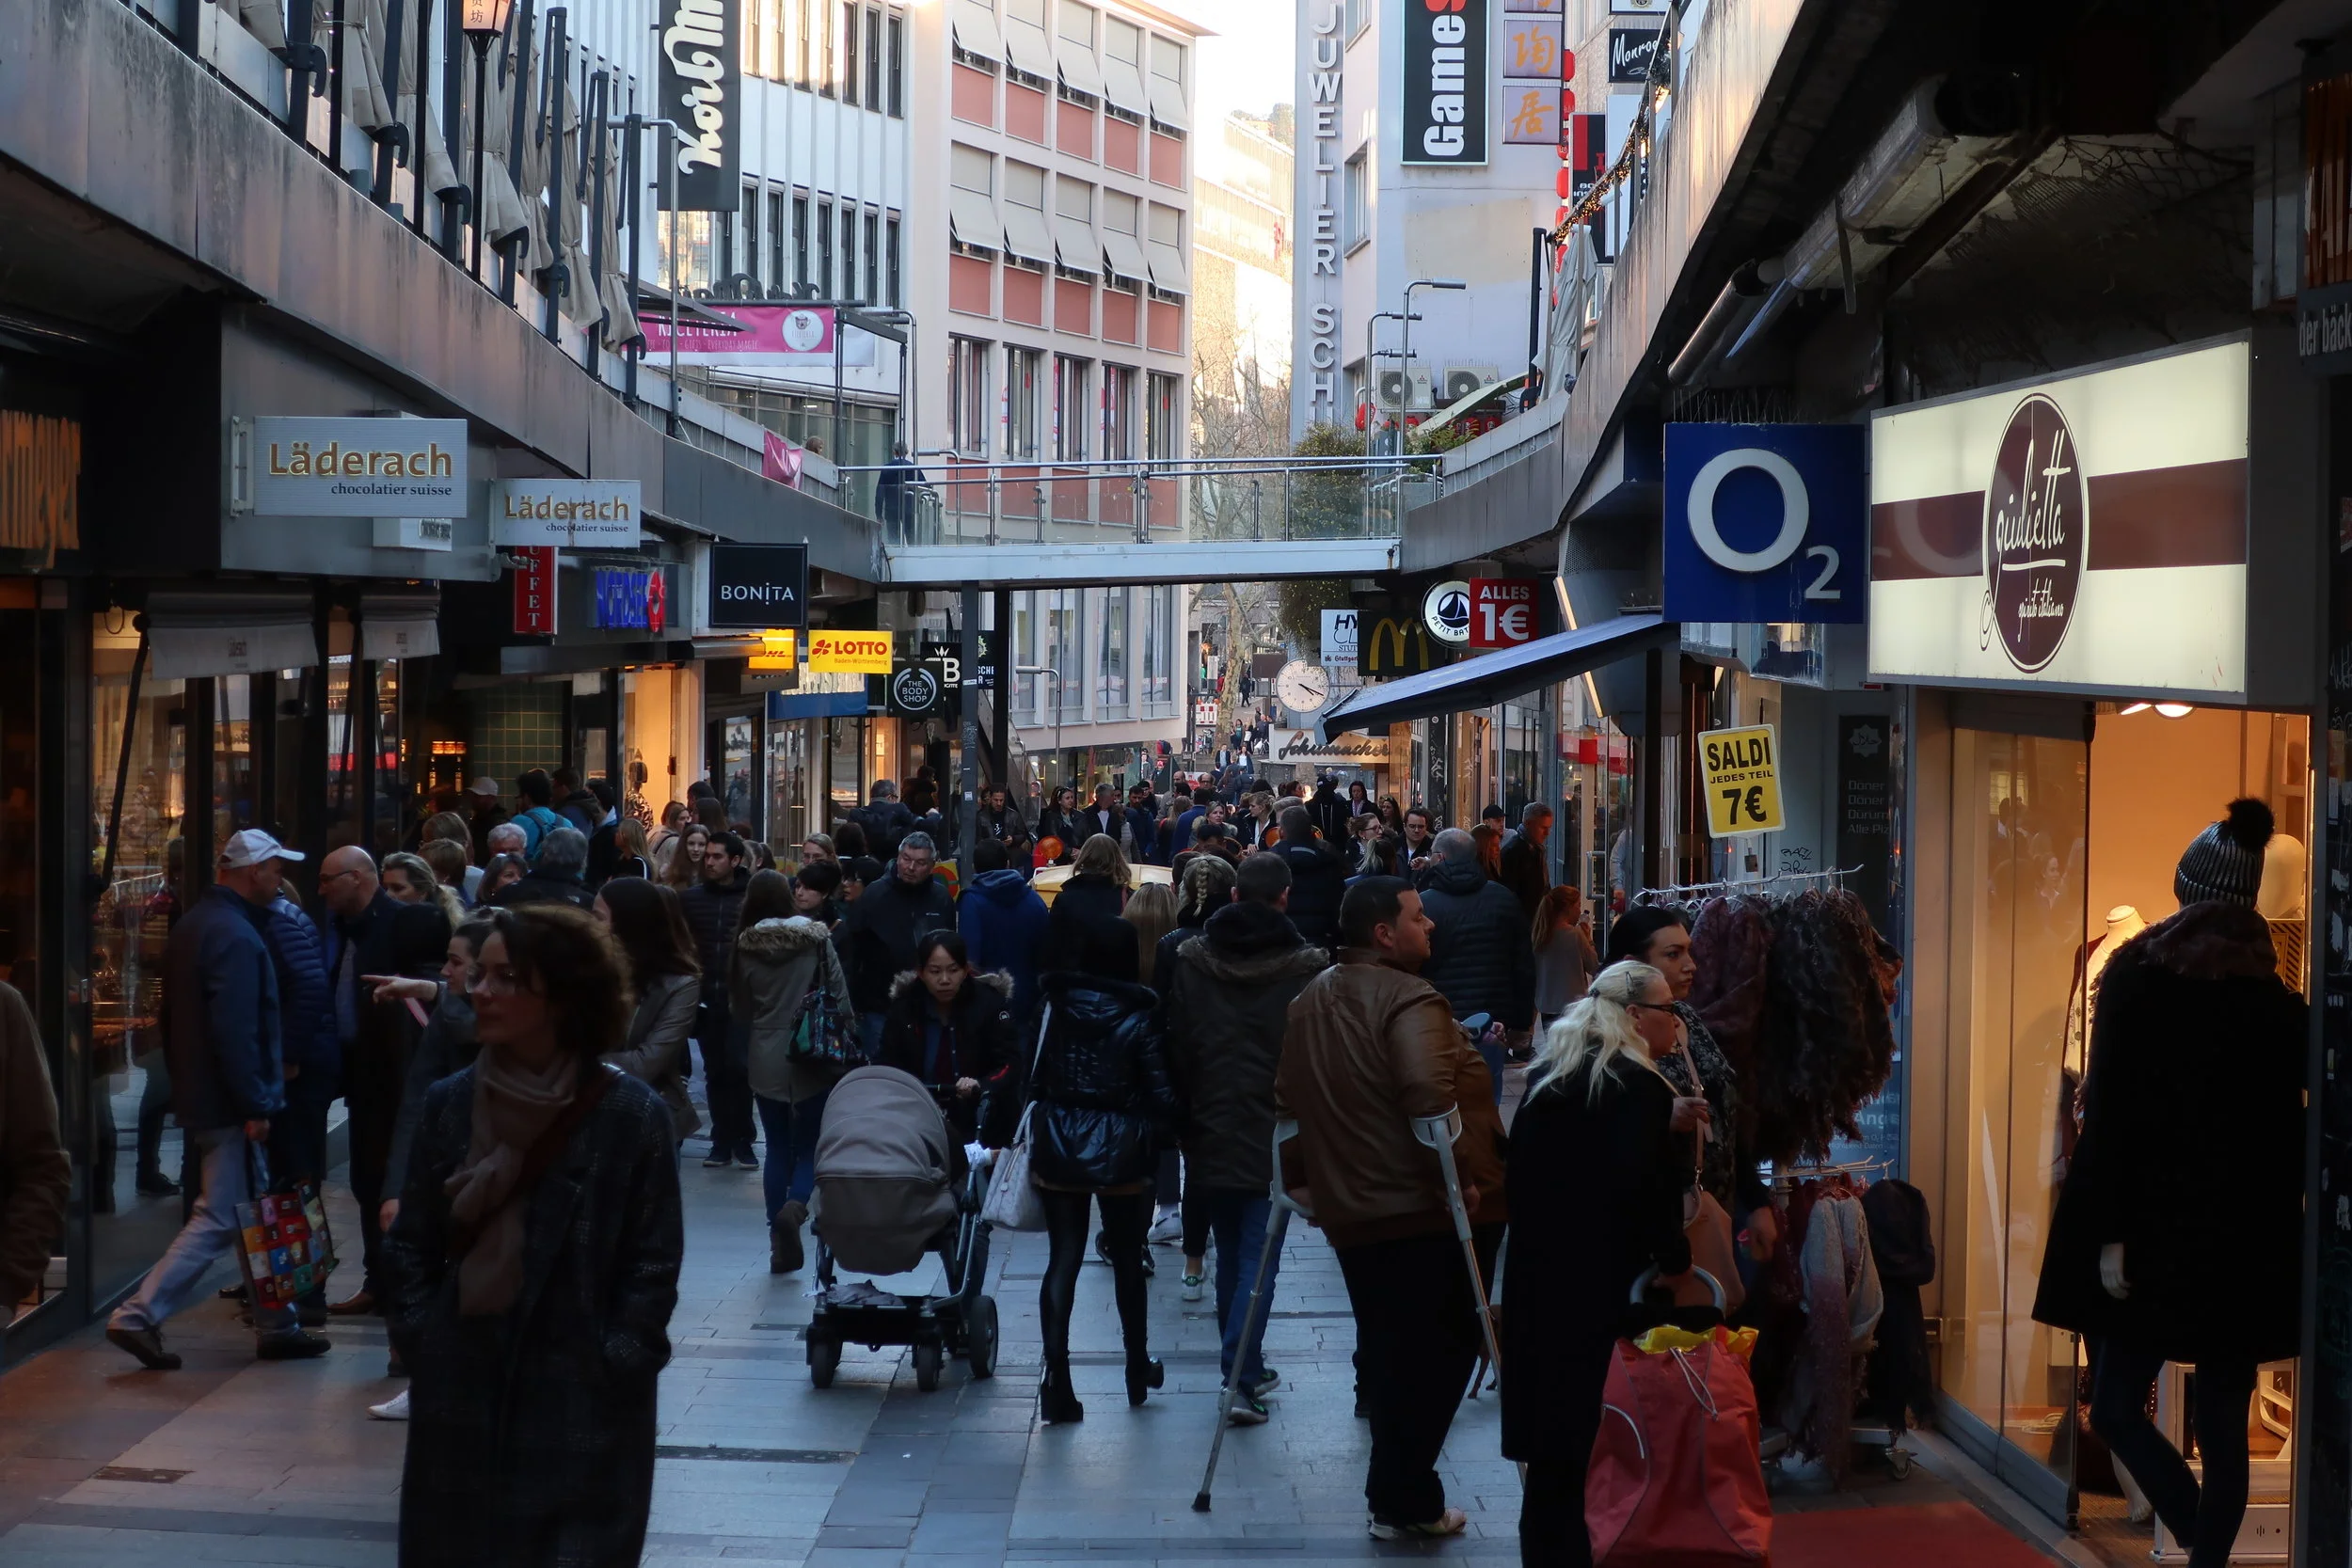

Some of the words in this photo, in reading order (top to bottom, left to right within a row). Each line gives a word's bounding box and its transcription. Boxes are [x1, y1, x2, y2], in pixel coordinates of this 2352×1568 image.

[1307, 3, 1343, 276] JUWELIER
[2299, 311, 2318, 356] der
[269, 440, 453, 478] Läderach
[331, 483, 406, 496] chocolatier
[410, 483, 453, 496] suisse
[504, 493, 629, 521] Läderach
[546, 523, 597, 532] chocolatier
[600, 524, 628, 532] suisse
[1480, 585, 1530, 600] ALLES
[1432, 616, 1451, 635] PETIT
[1480, 603, 1530, 641] 1€
[834, 641, 887, 656] LOTTO
[1707, 736, 1772, 772] SALDI
[1710, 773, 1745, 784] JEDES
[1748, 770, 1773, 780] TEIL
[1722, 785, 1767, 825] 7€
